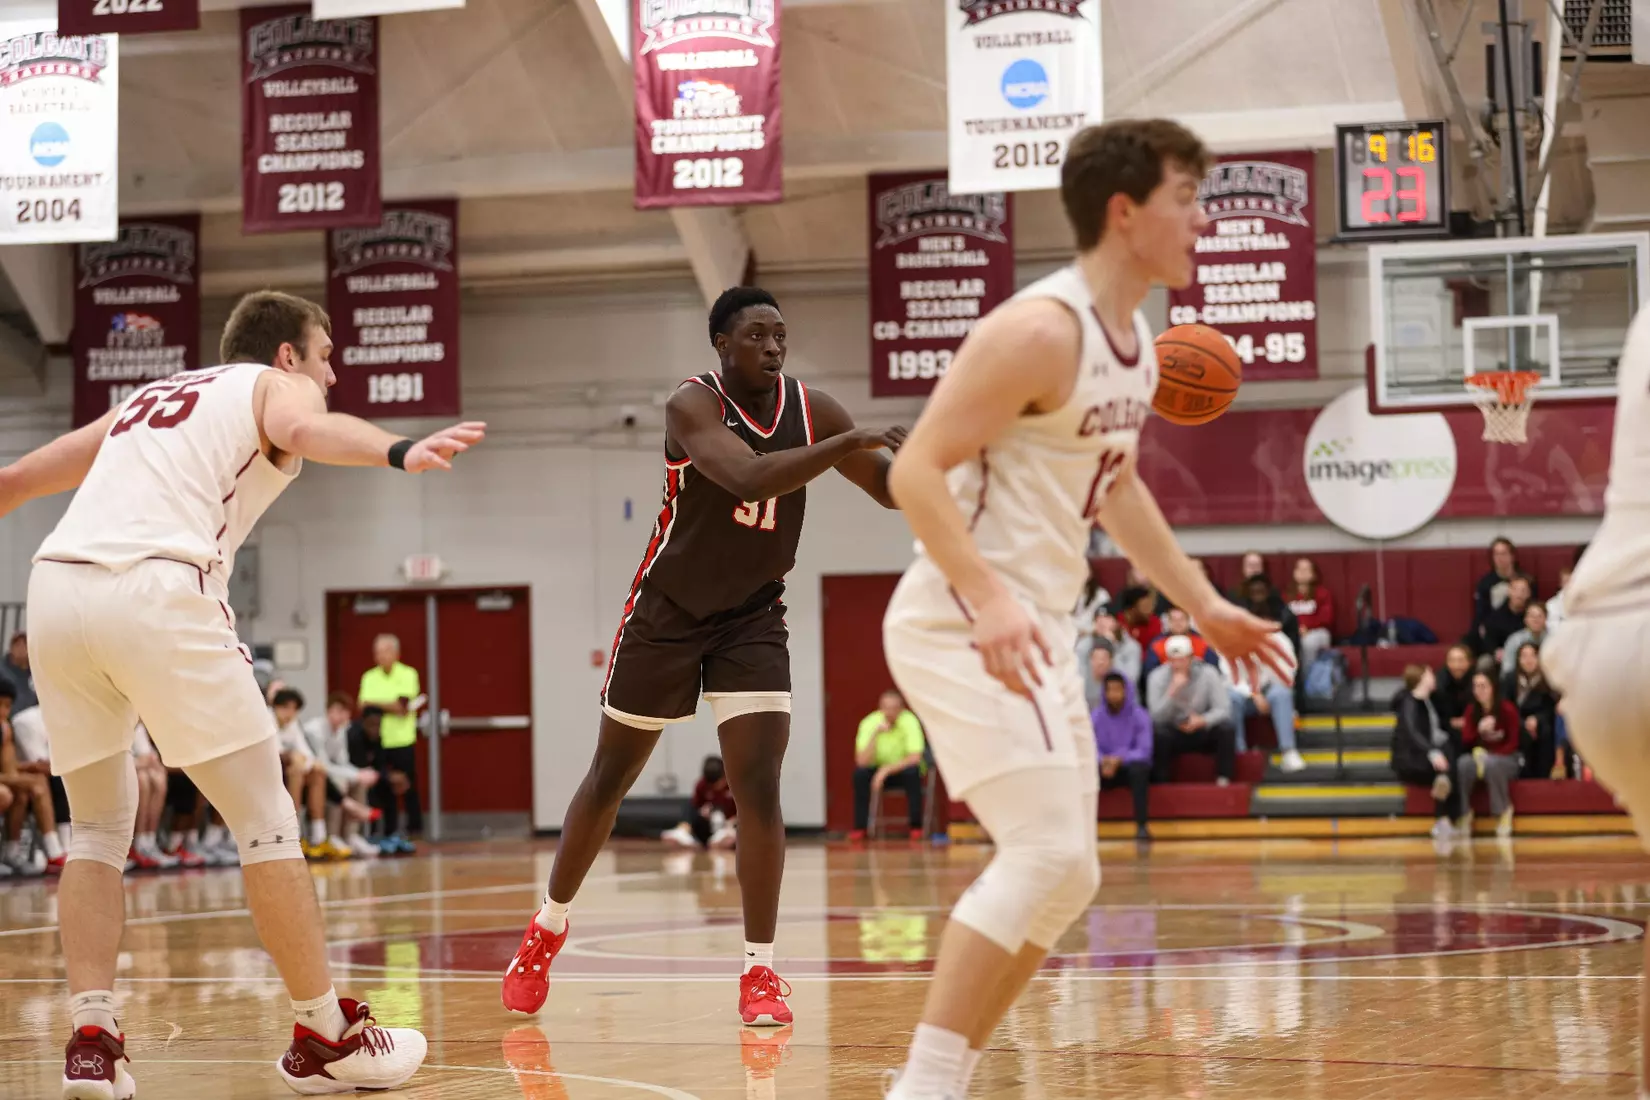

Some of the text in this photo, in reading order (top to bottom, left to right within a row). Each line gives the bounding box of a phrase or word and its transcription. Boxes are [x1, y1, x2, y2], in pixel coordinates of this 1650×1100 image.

[973, 29, 1074, 49] VOLLEYBALL
[262, 76, 359, 98] VOLLEYBALL
[269, 110, 352, 133] REGULAR
[963, 112, 1087, 136] TOURNAMENT
[275, 131, 346, 152] SEASON
[258, 150, 364, 174] CHAMPIONS
[993, 141, 1061, 169] 2012
[0, 172, 104, 191] TOURNAMENT
[673, 157, 744, 189] 2012
[278, 181, 345, 213] 2012
[1361, 166, 1427, 222] 23
[16, 198, 82, 223] 2004
[346, 272, 439, 294] VOLLEYBALL
[1197, 261, 1286, 284] REGULAR
[93, 285, 181, 305] VOLLEYBALL
[900, 278, 985, 299] REGULAR
[1204, 282, 1280, 304] SEASON
[353, 305, 433, 327] REGULAR
[906, 297, 980, 319] SEASON
[1170, 300, 1316, 325] CO-CHAMPIONS
[359, 324, 428, 346] SEASON
[342, 342, 444, 366] CHAMPIONS
[1223, 332, 1306, 364] 4-95
[368, 373, 424, 404] 1991
[110, 376, 217, 437] 55
[1309, 456, 1452, 487] imagepress
